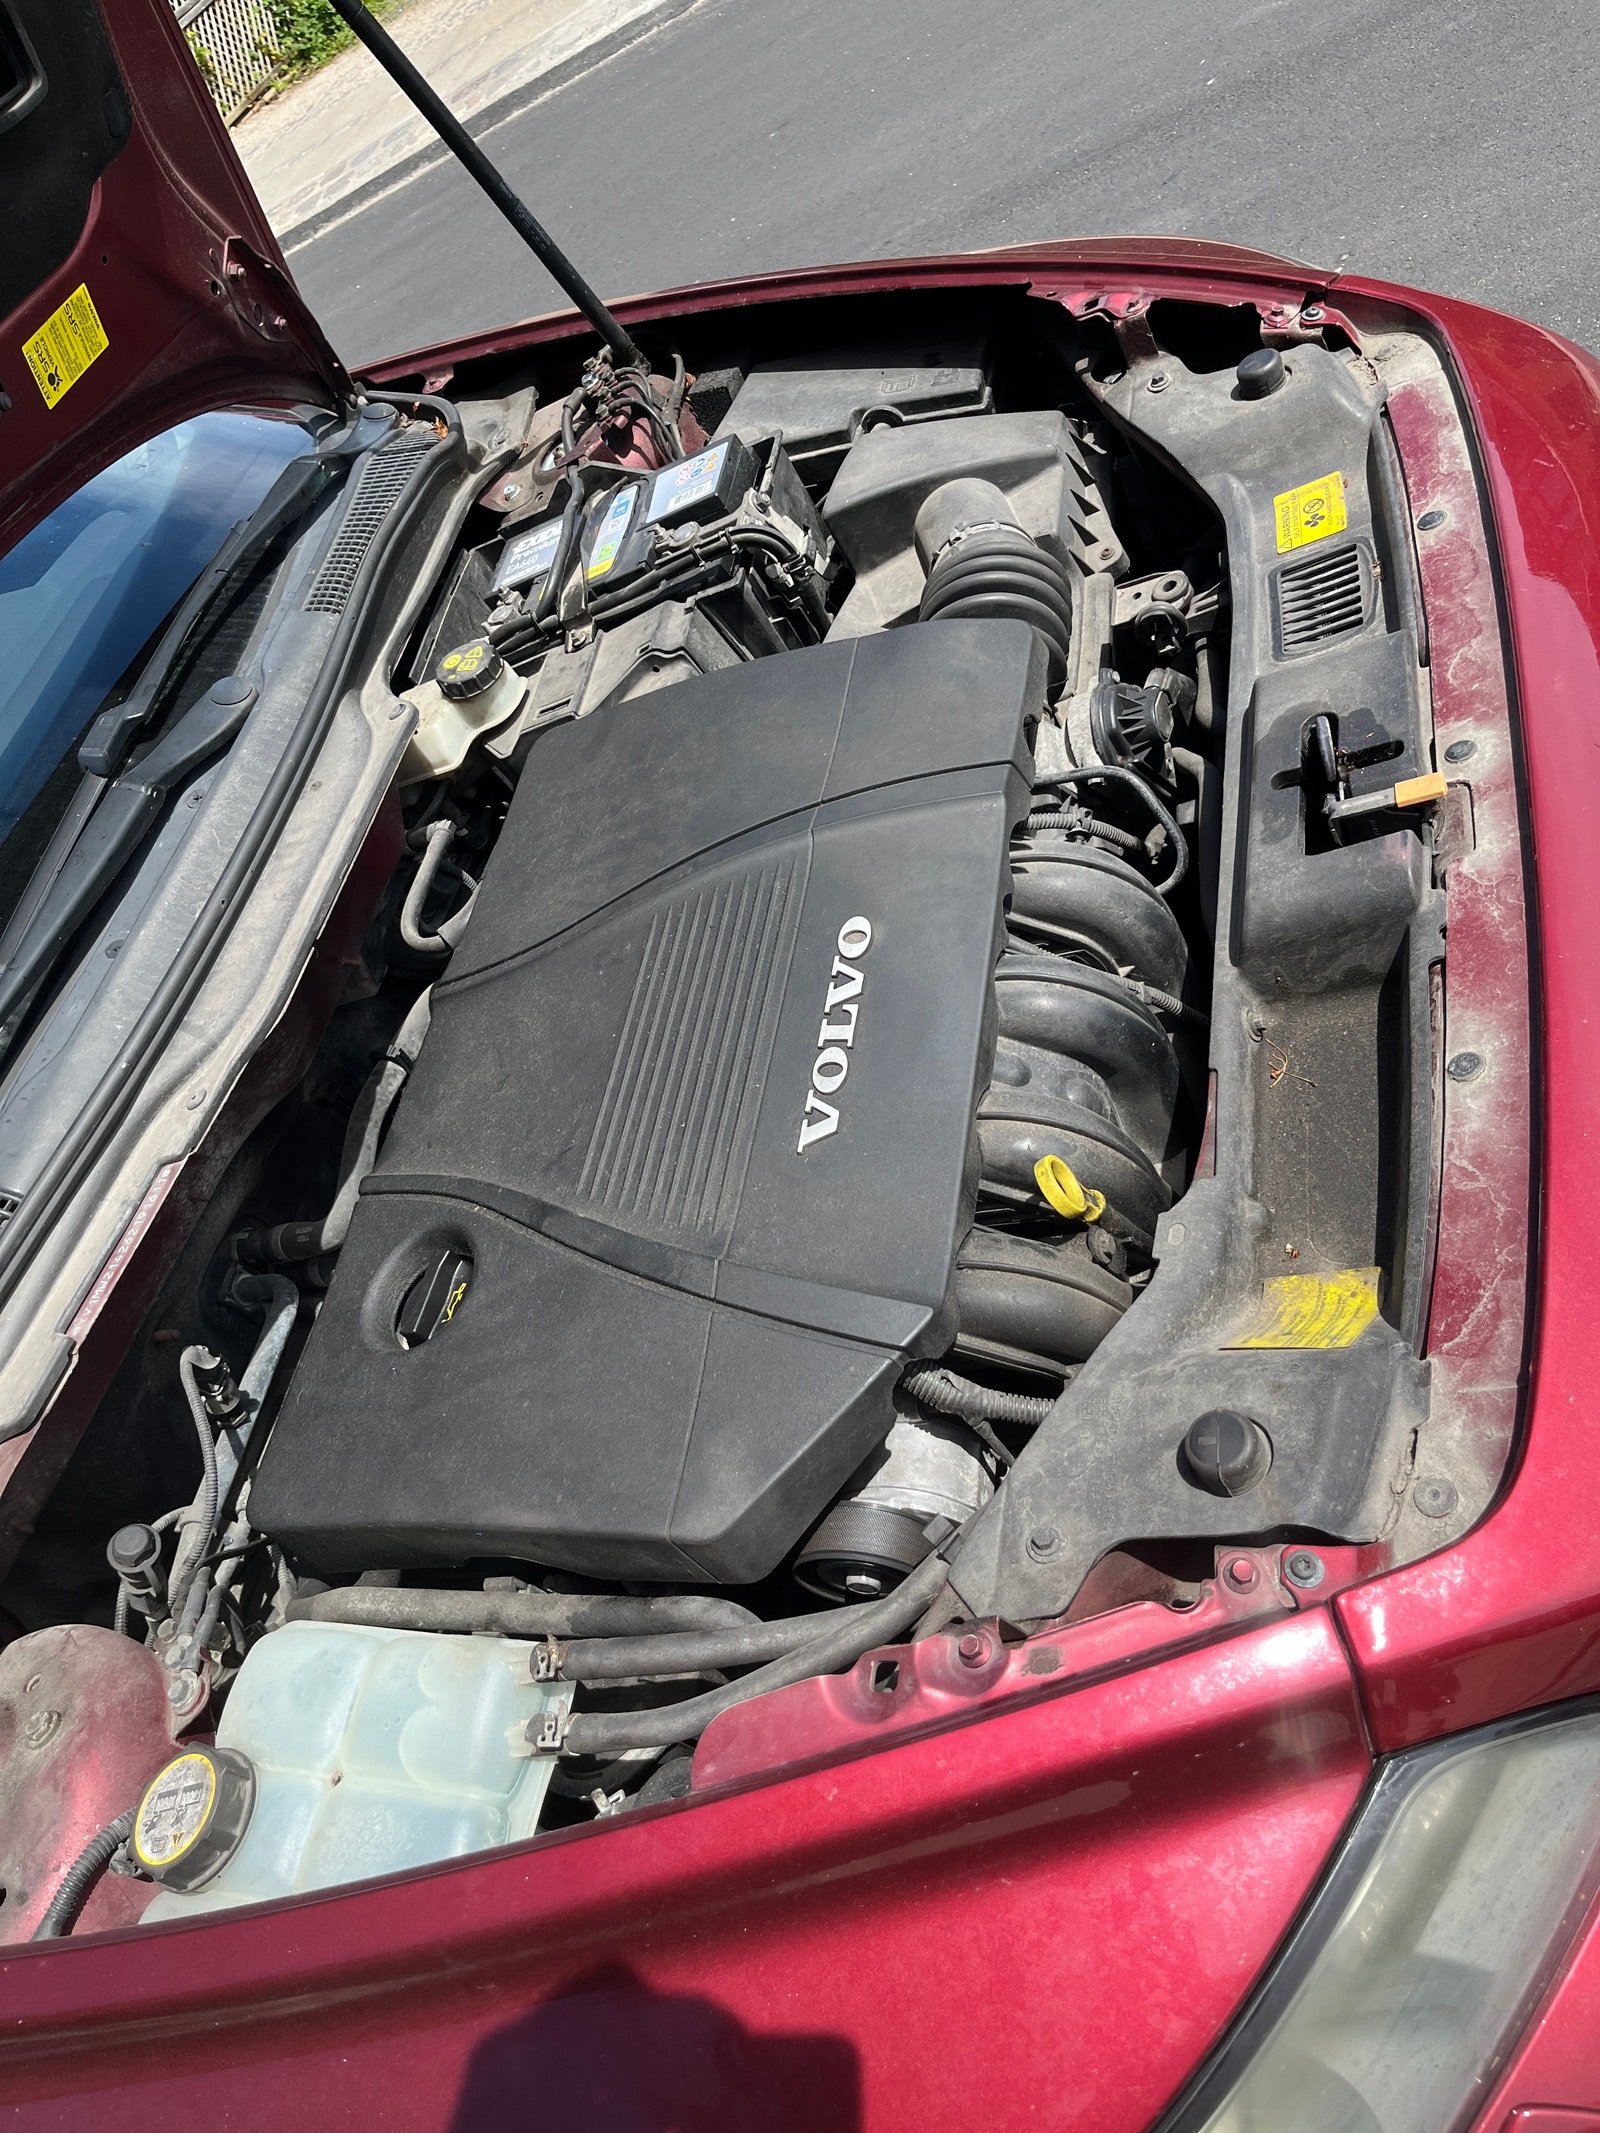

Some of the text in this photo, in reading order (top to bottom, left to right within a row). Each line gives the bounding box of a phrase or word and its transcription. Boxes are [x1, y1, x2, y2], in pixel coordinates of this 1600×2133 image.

[62, 302, 80, 336] SRS
[32, 340, 50, 373] SRS
[40, 335, 55, 367] VEHICLE
[1281, 506, 1291, 538] WARNING
[797, 915, 873, 1155] VOLVO
